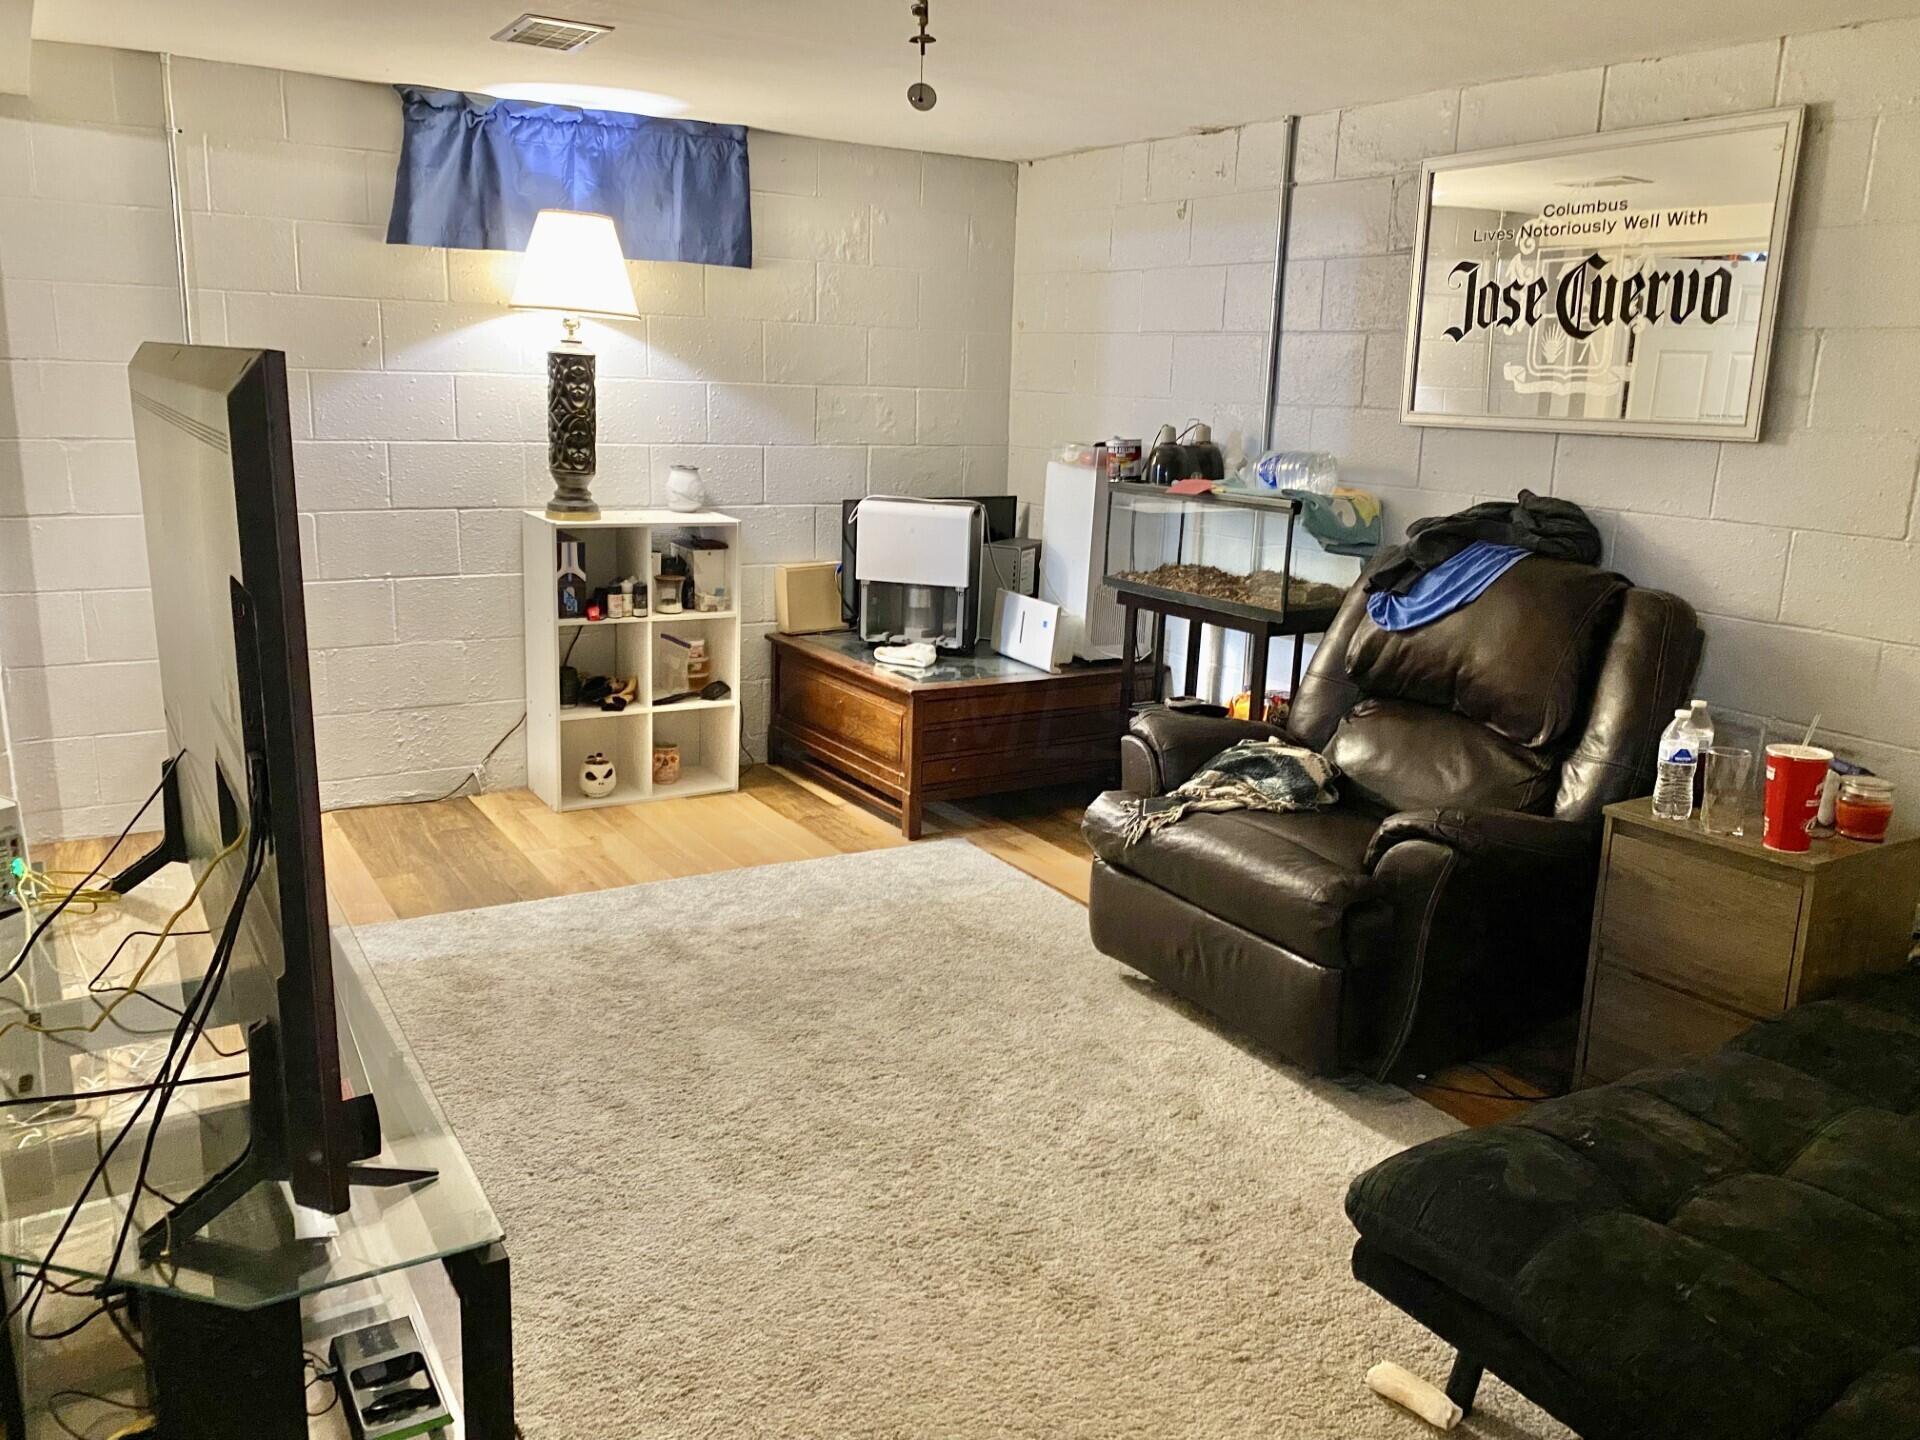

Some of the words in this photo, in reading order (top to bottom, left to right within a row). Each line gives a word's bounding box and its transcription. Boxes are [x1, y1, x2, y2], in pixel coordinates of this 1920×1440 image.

[1473, 229, 1514, 242] Lives
[1520, 218, 1617, 239] Notoriously
[1624, 213, 1661, 230] Well
[1667, 209, 1708, 227] With
[1543, 200, 1629, 218] Columbus
[1442, 261, 1548, 343] Jose
[1556, 252, 1733, 340] Cuervo
